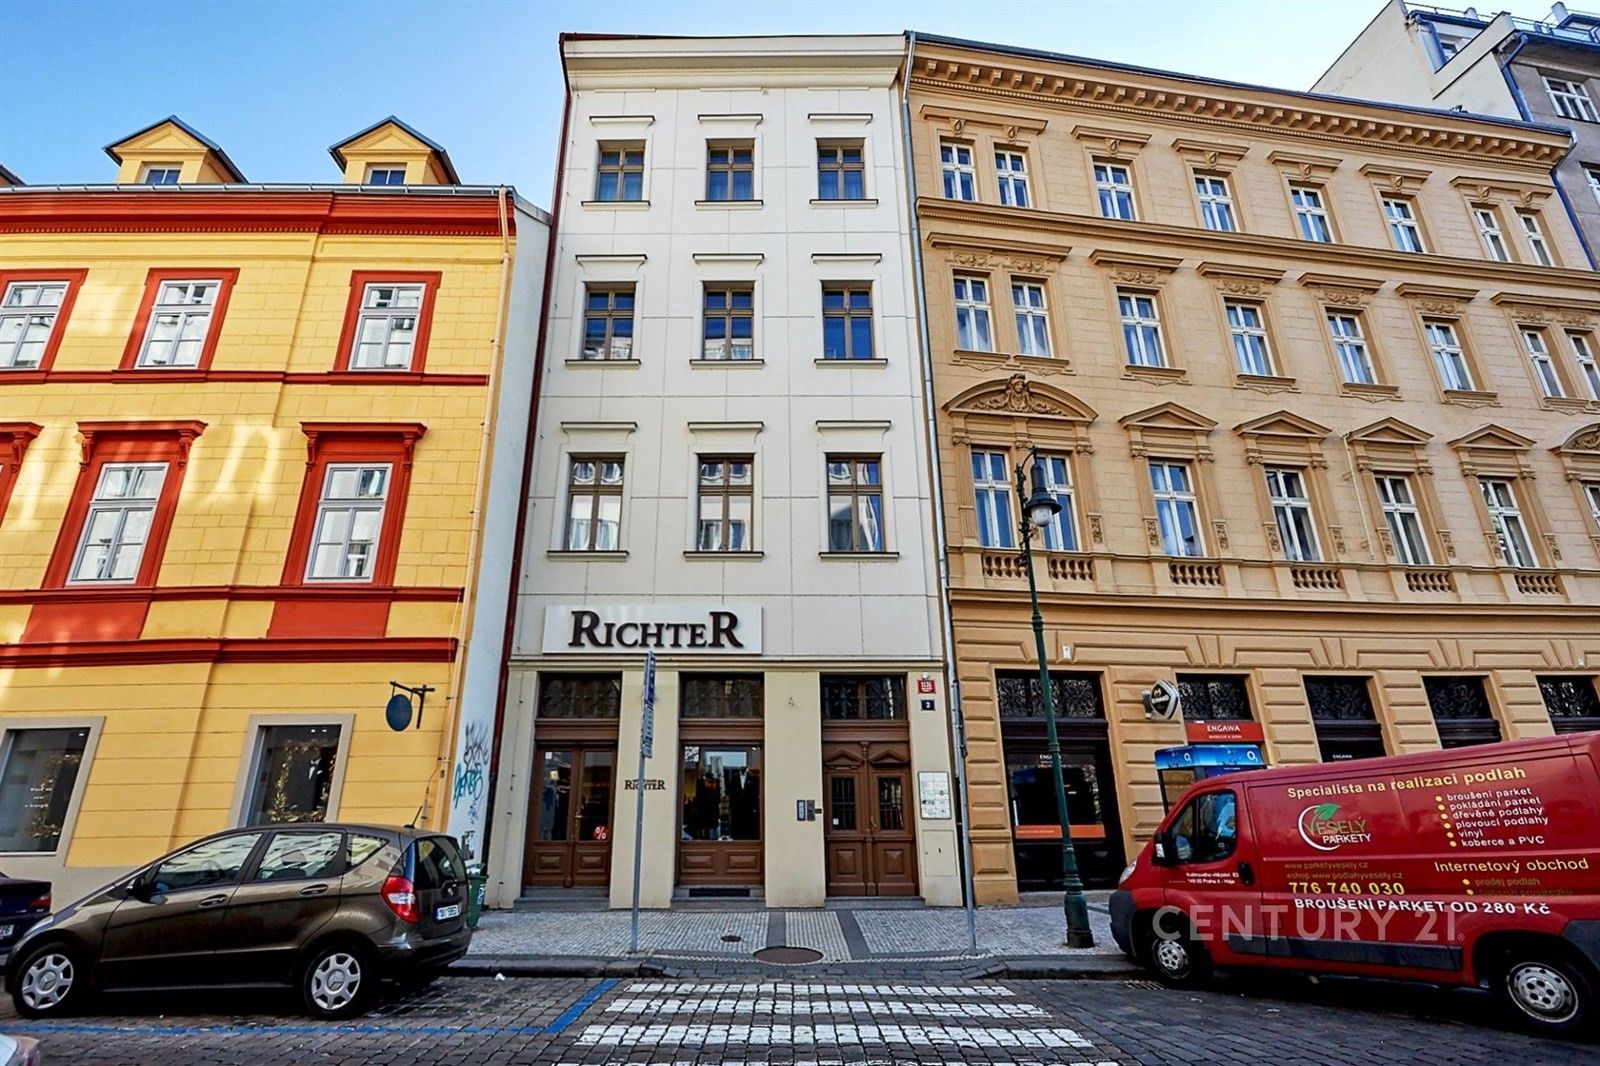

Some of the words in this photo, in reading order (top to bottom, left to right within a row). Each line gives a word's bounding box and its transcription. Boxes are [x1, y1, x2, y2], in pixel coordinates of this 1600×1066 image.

[567, 610, 744, 648] RICHTER
[1287, 783, 1363, 799] Specialista
[1368, 782, 1386, 792] na
[1390, 773, 1458, 790] realizaci
[1463, 766, 1526, 785] podlah
[1496, 787, 1532, 799] parket
[1504, 796, 1541, 807] parket
[1499, 805, 1543, 818] podlahy
[1504, 815, 1549, 828] podlahy
[1322, 833, 1371, 844] PARKETY
[1458, 829, 1483, 839] vinyl
[1461, 837, 1505, 847] koberce
[1508, 838, 1516, 846] a
[1518, 835, 1545, 845] PVC
[1434, 859, 1520, 873] Internetový
[1526, 857, 1589, 871] obchod
[1288, 882, 1321, 894] 776
[1327, 882, 1361, 895] 740
[1368, 882, 1405, 895] 030
[1294, 897, 1374, 910] BROUŠENÍ
[1377, 900, 1445, 912] PARKET
[1450, 901, 1477, 913] OD
[1483, 902, 1516, 914] 280
[1524, 902, 1550, 915] Kč
